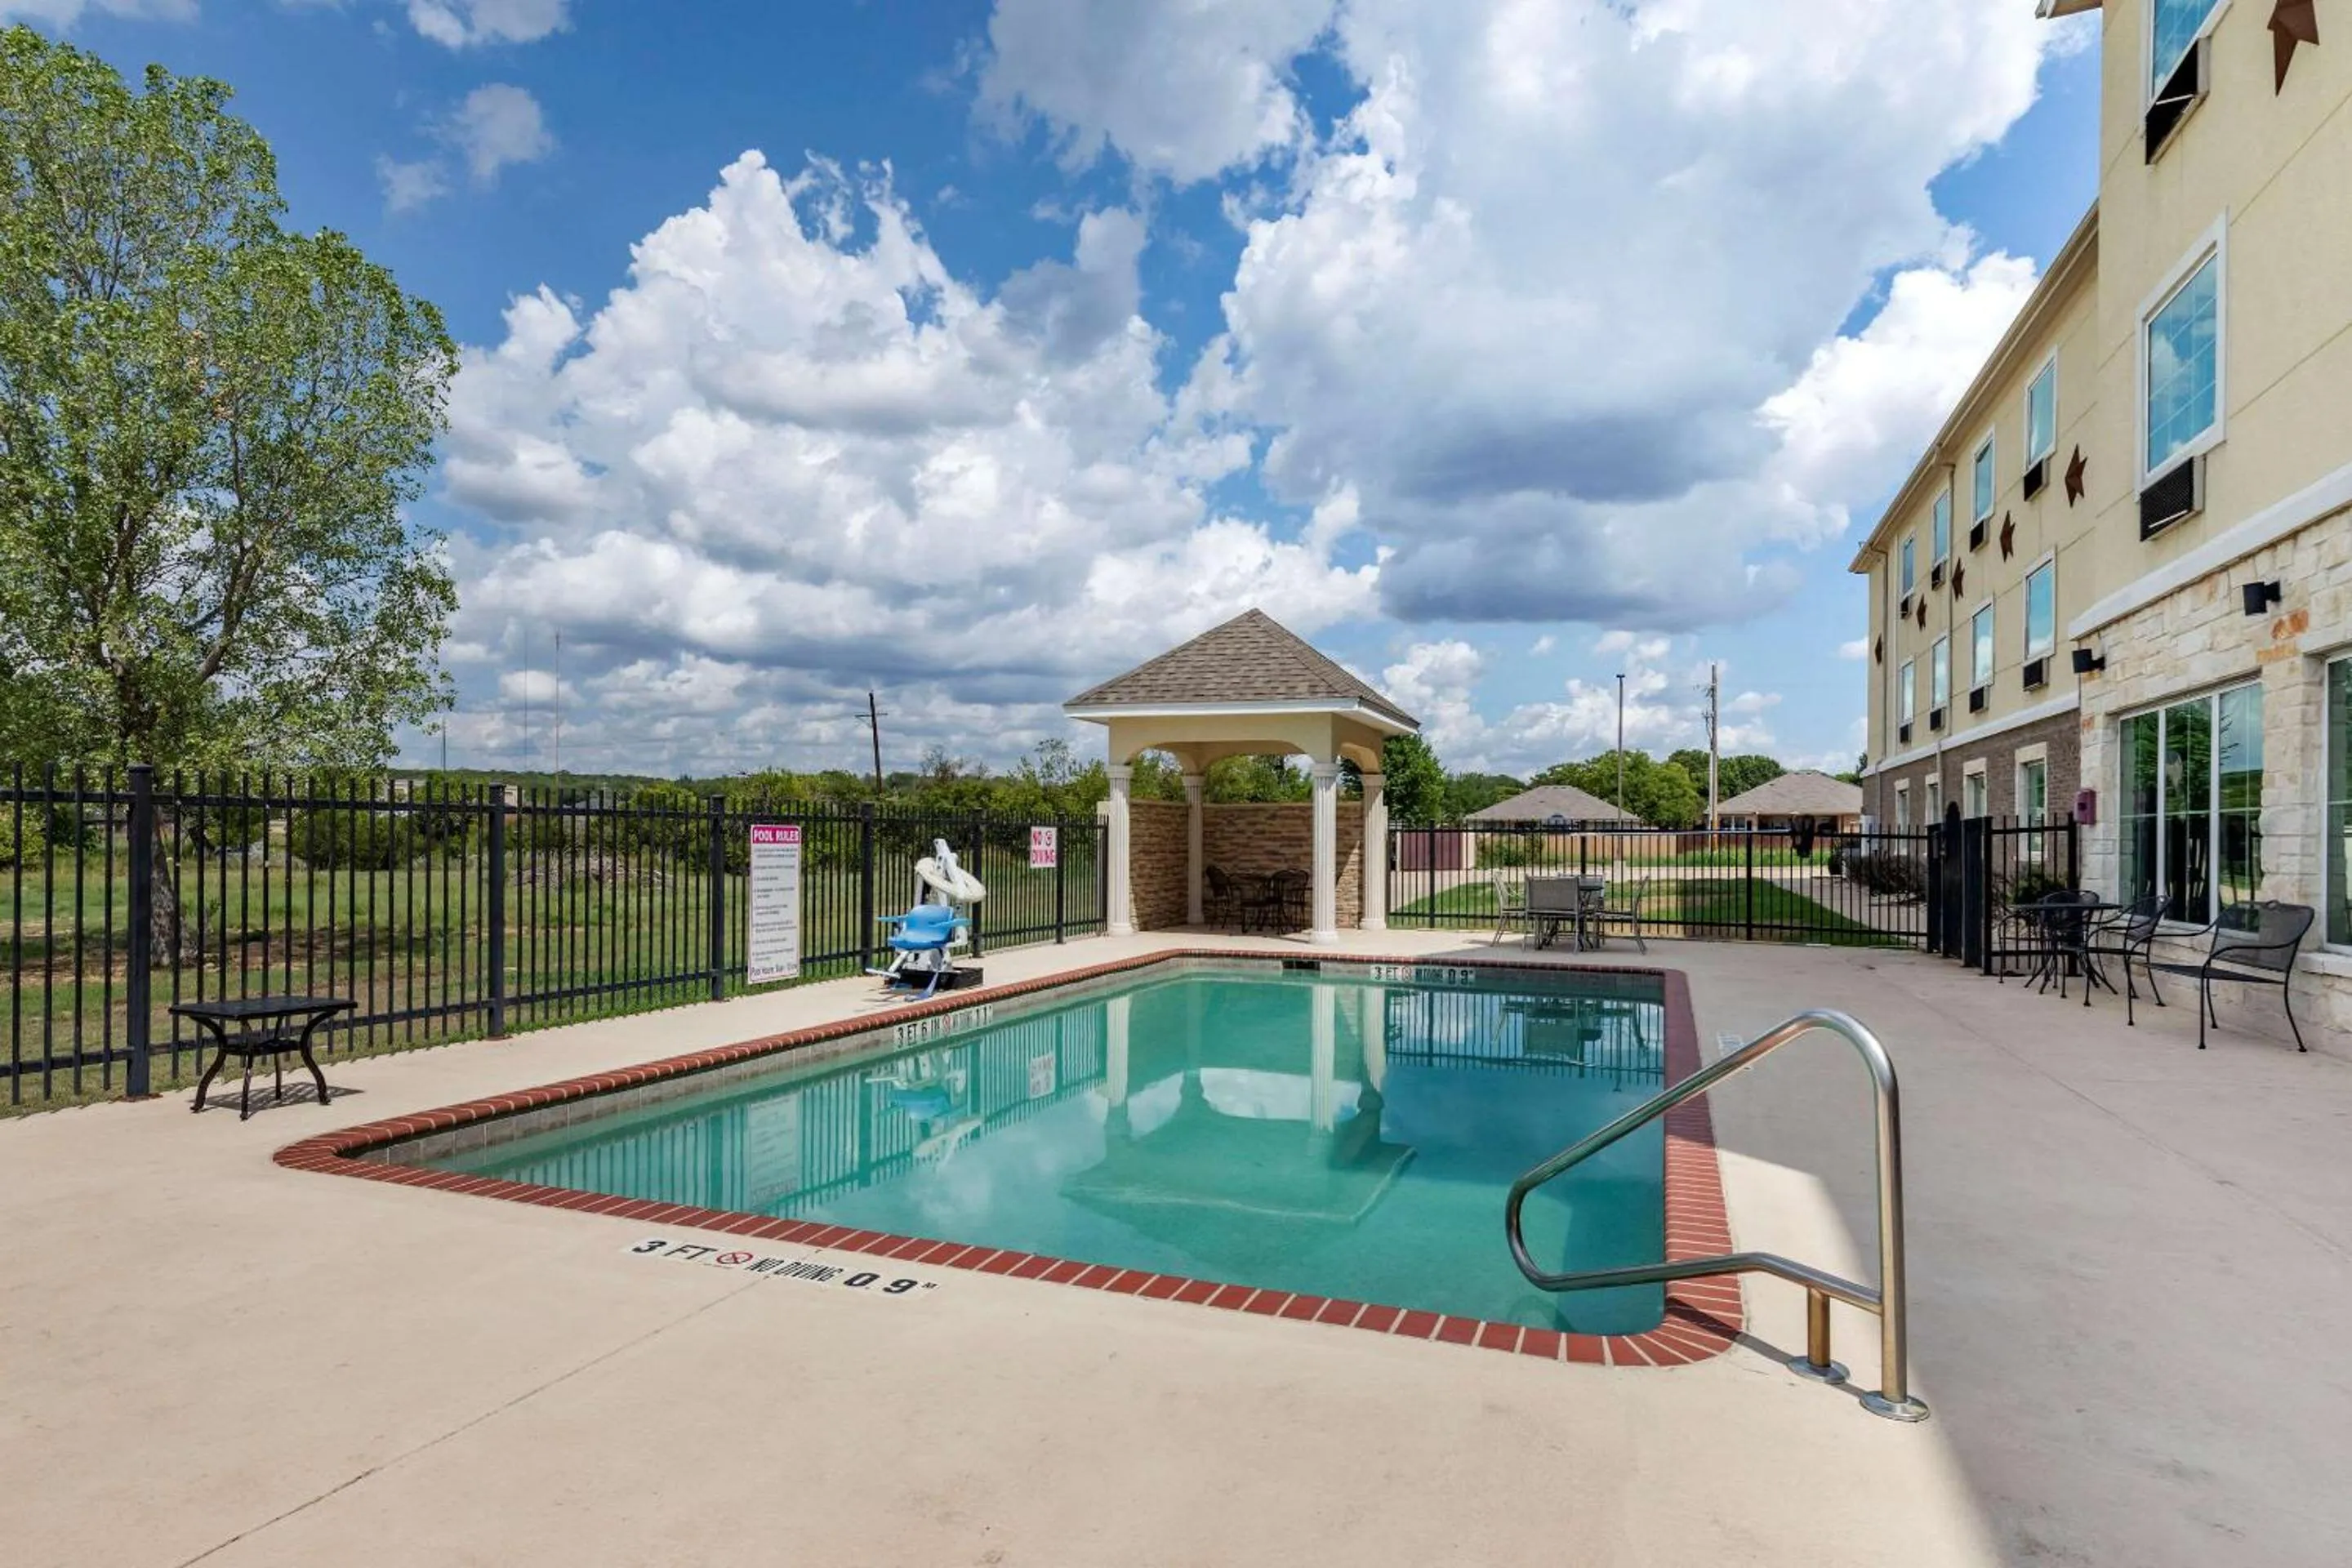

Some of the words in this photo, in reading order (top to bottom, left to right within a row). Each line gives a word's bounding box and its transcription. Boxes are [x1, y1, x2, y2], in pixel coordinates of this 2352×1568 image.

[754, 829, 773, 841] POOL
[776, 830, 799, 841] RULES
[632, 1240, 667, 1254] 3
[662, 1244, 718, 1260] FT
[745, 1258, 785, 1272] NO
[773, 1262, 844, 1282] DIVING
